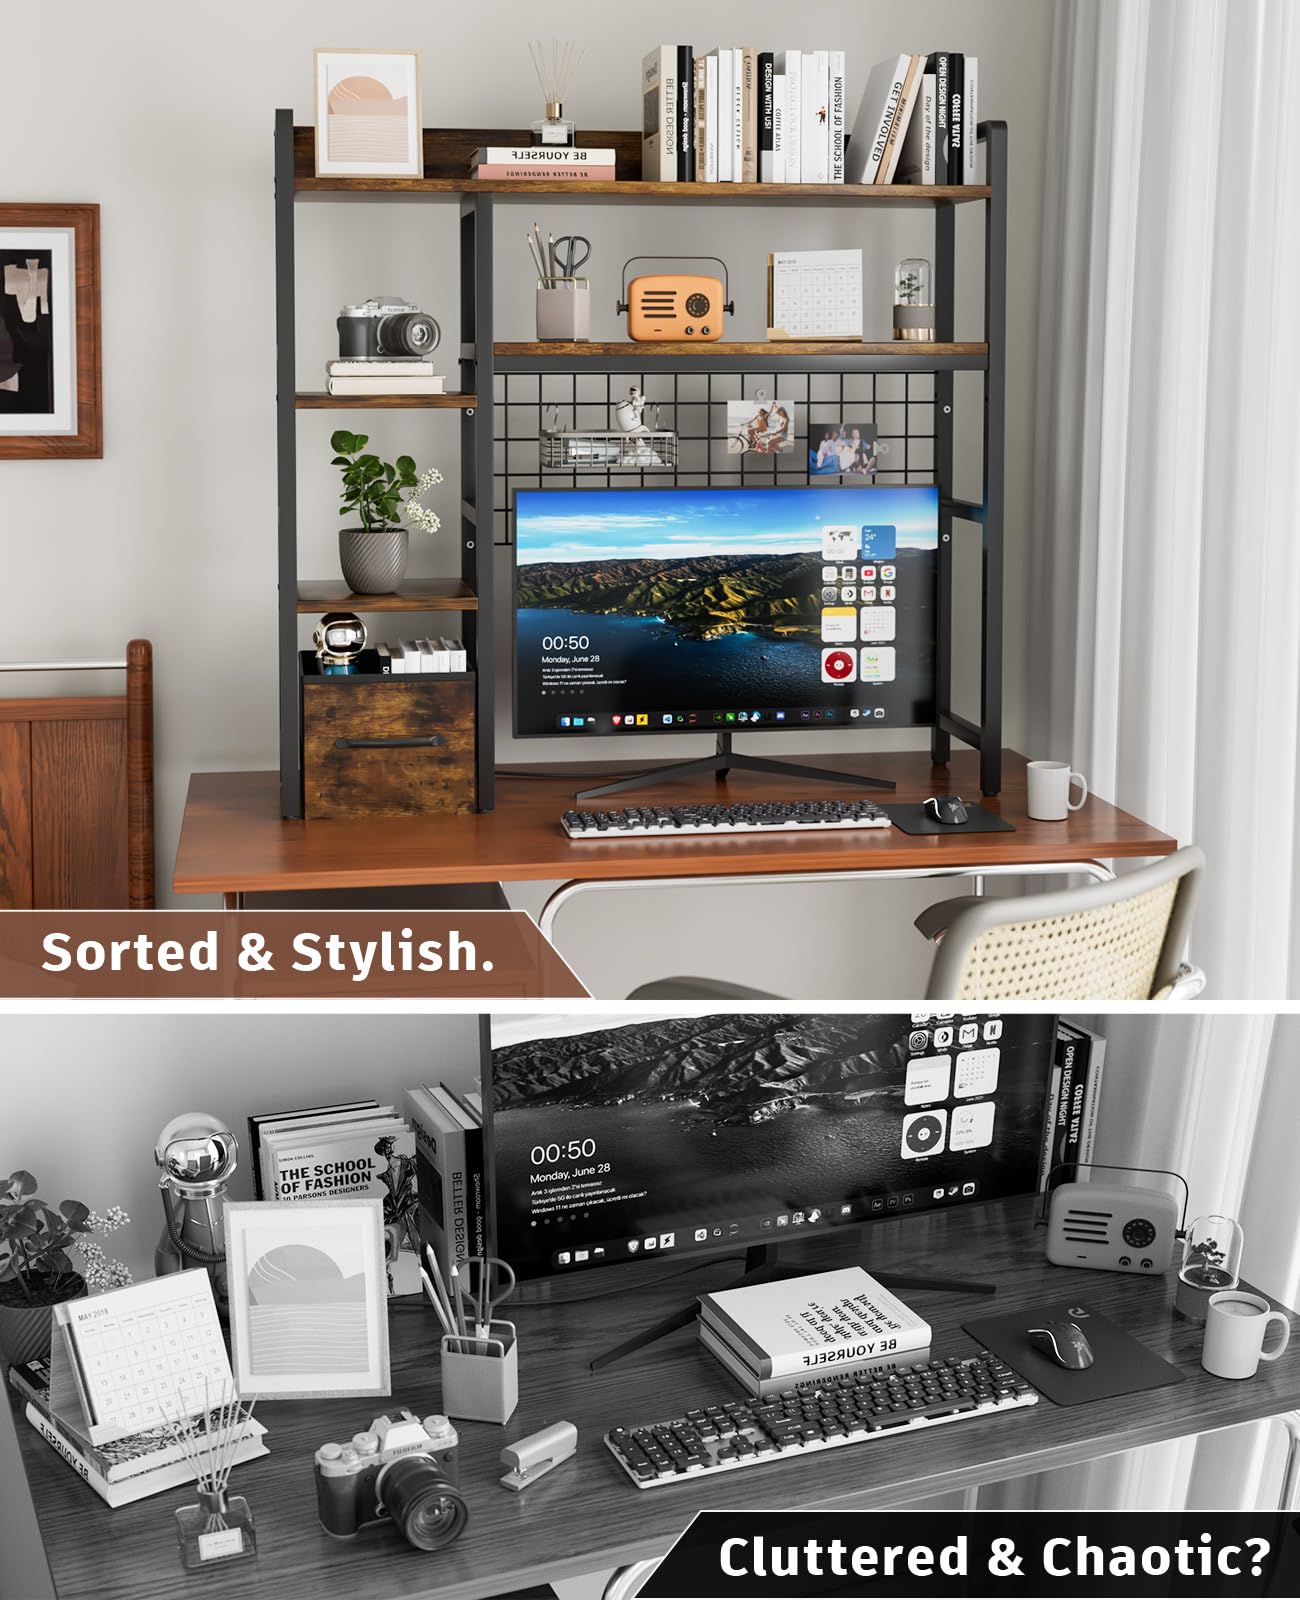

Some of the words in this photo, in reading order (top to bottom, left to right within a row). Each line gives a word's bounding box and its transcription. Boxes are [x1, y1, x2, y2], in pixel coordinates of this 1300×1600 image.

[764, 62, 773, 92] DESIGN
[938, 56, 947, 77] OPEN
[834, 76, 843, 113] FASHION
[891, 81, 903, 103] GET
[938, 78, 947, 105] DESIGN
[764, 94, 773, 115] WITH
[764, 116, 773, 129] US!
[834, 115, 843, 126] OF
[889, 97, 907, 145] MINIMALISM
[925, 115, 932, 124] of
[938, 106, 947, 129] NIGHT
[834, 129, 843, 162] SCHOOL
[872, 106, 897, 162] INVOLVED
[924, 142, 932, 172] design
[834, 164, 843, 181] THE
[542, 635, 590, 651] 00:50
[541, 656, 571, 664] Monday,
[589, 655, 600, 663] 28
[1064, 1046, 1075, 1069] OPEN
[1060, 1070, 1072, 1100] DESIGN
[1057, 1101, 1069, 1127] NIGHT
[530, 1138, 596, 1165] 00:50
[280, 1166, 310, 1182] THE
[313, 1158, 376, 1176] SCHOOL
[530, 1170, 571, 1184] Monday,
[572, 1167, 595, 1178] June
[597, 1163, 611, 1174] 28
[281, 1181, 301, 1195] OF
[305, 1171, 372, 1192] FASHION
[293, 1190, 328, 1201] PARSONS
[329, 1184, 370, 1196] DESIGNERS
[78, 1312, 92, 1322] MAY
[93, 1308, 109, 1318] 2018
